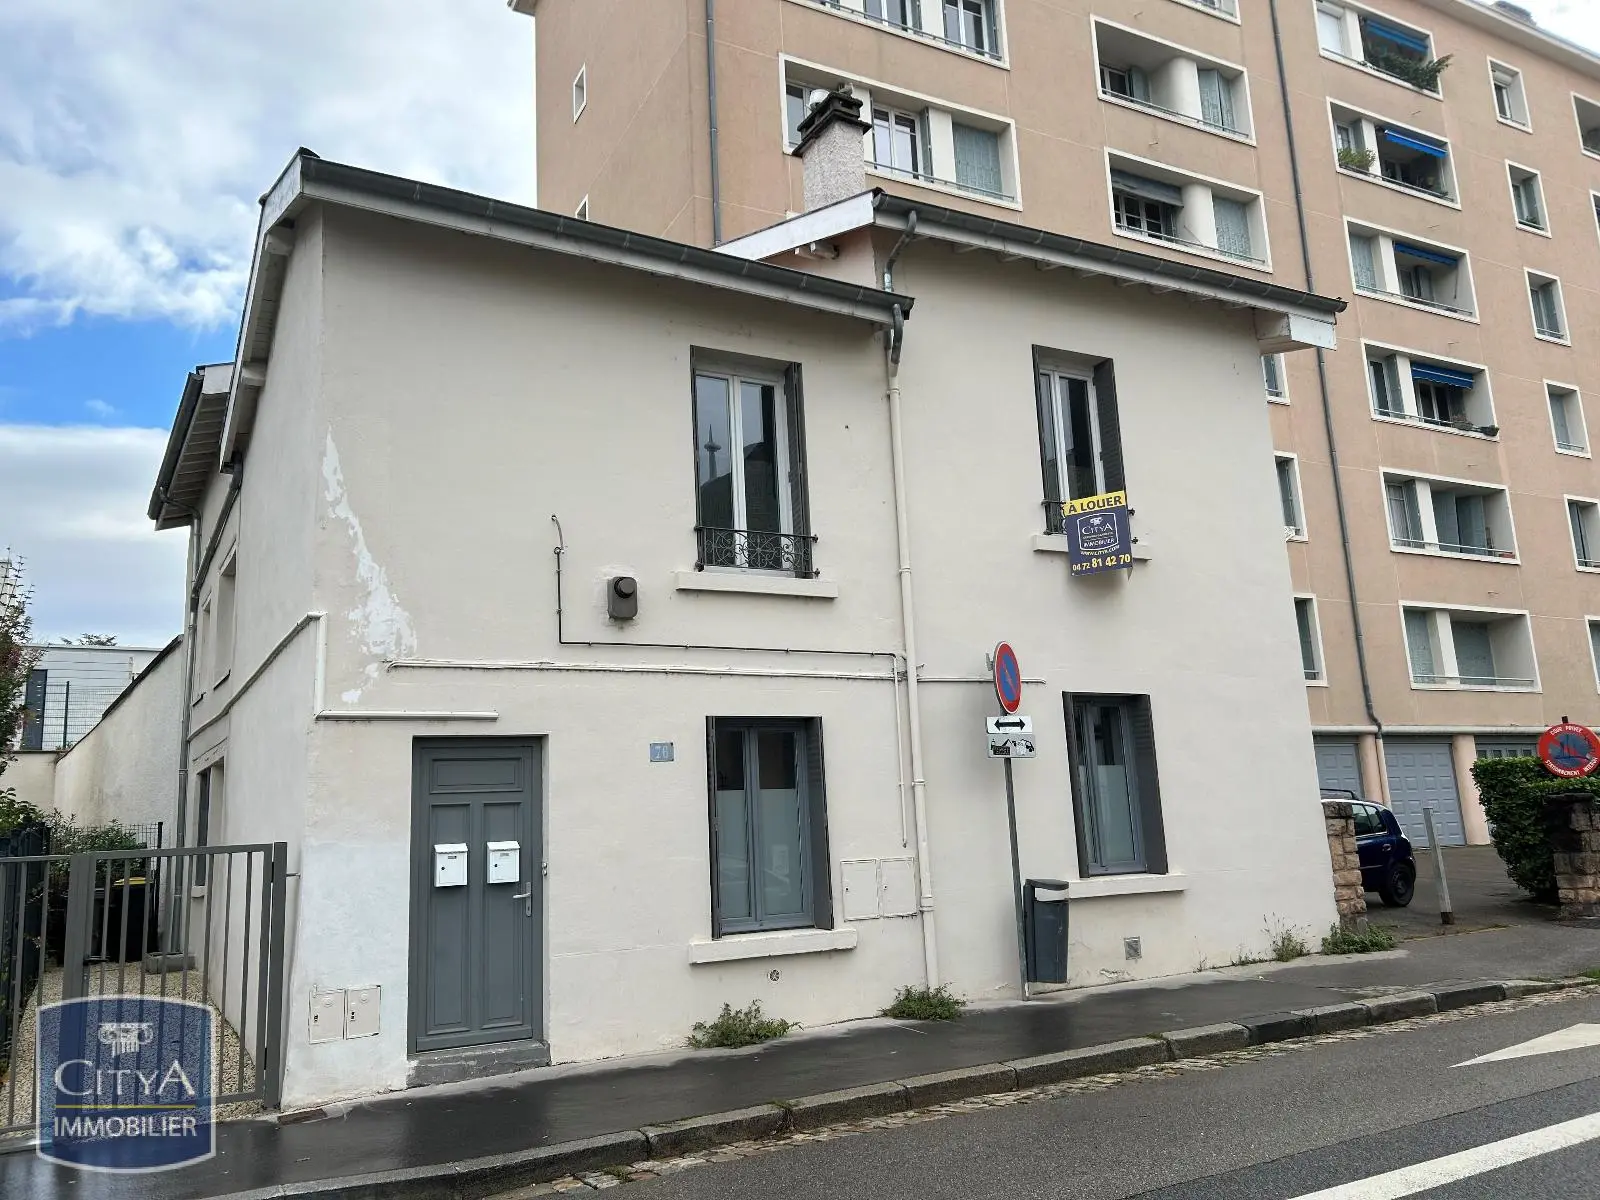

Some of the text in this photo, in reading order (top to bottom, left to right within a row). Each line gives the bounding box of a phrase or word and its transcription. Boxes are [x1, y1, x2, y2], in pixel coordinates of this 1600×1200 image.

[1080, 495, 1122, 512] LOUER
[1072, 554, 1131, 571] 04 72 81 42 70
[1545, 759, 1581, 776] STATIONNEMENT
